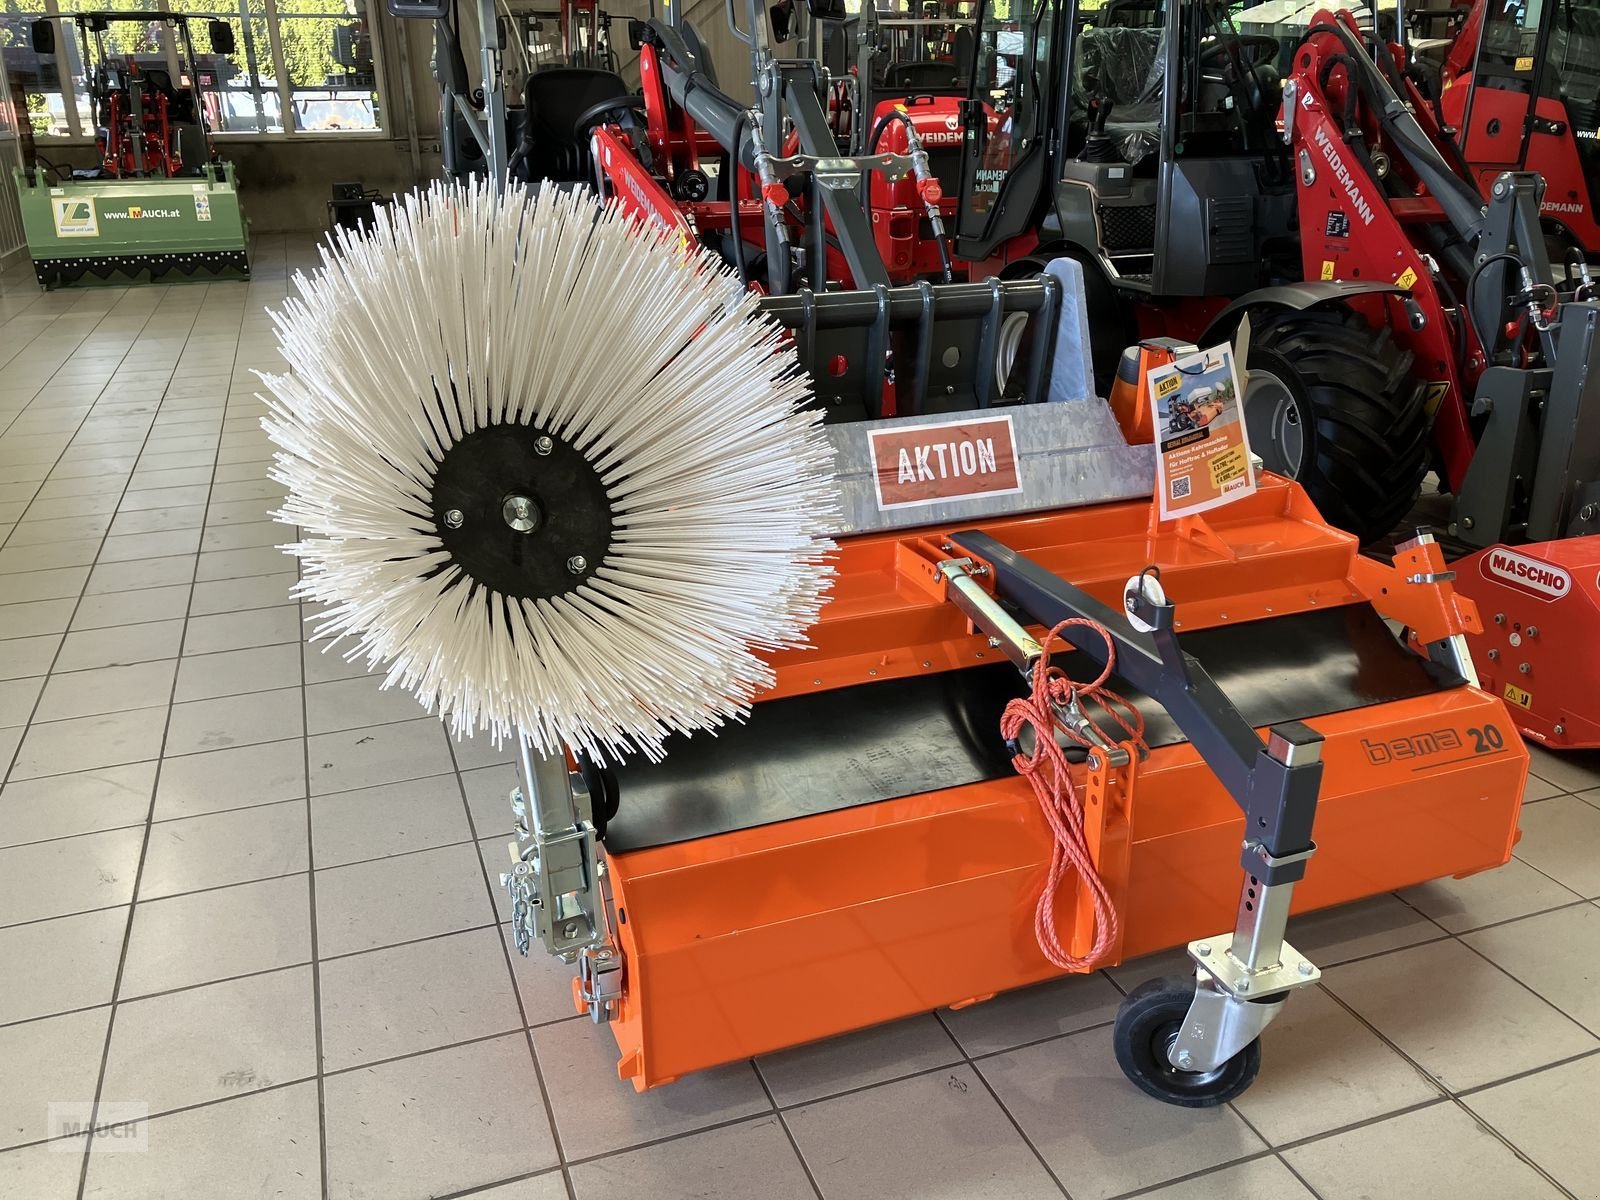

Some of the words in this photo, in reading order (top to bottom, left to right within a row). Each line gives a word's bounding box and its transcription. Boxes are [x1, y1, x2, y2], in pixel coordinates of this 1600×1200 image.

[1314, 125, 1375, 226] WEIDEMANN
[104, 207, 181, 220] www.MAUCH.at
[1159, 376, 1179, 393] AKTION
[897, 437, 997, 485] AKTION
[1223, 480, 1244, 493] MAUCH
[1492, 554, 1566, 591] MASCHIO
[1360, 728, 1463, 766] bema
[1466, 723, 1504, 753] 20
